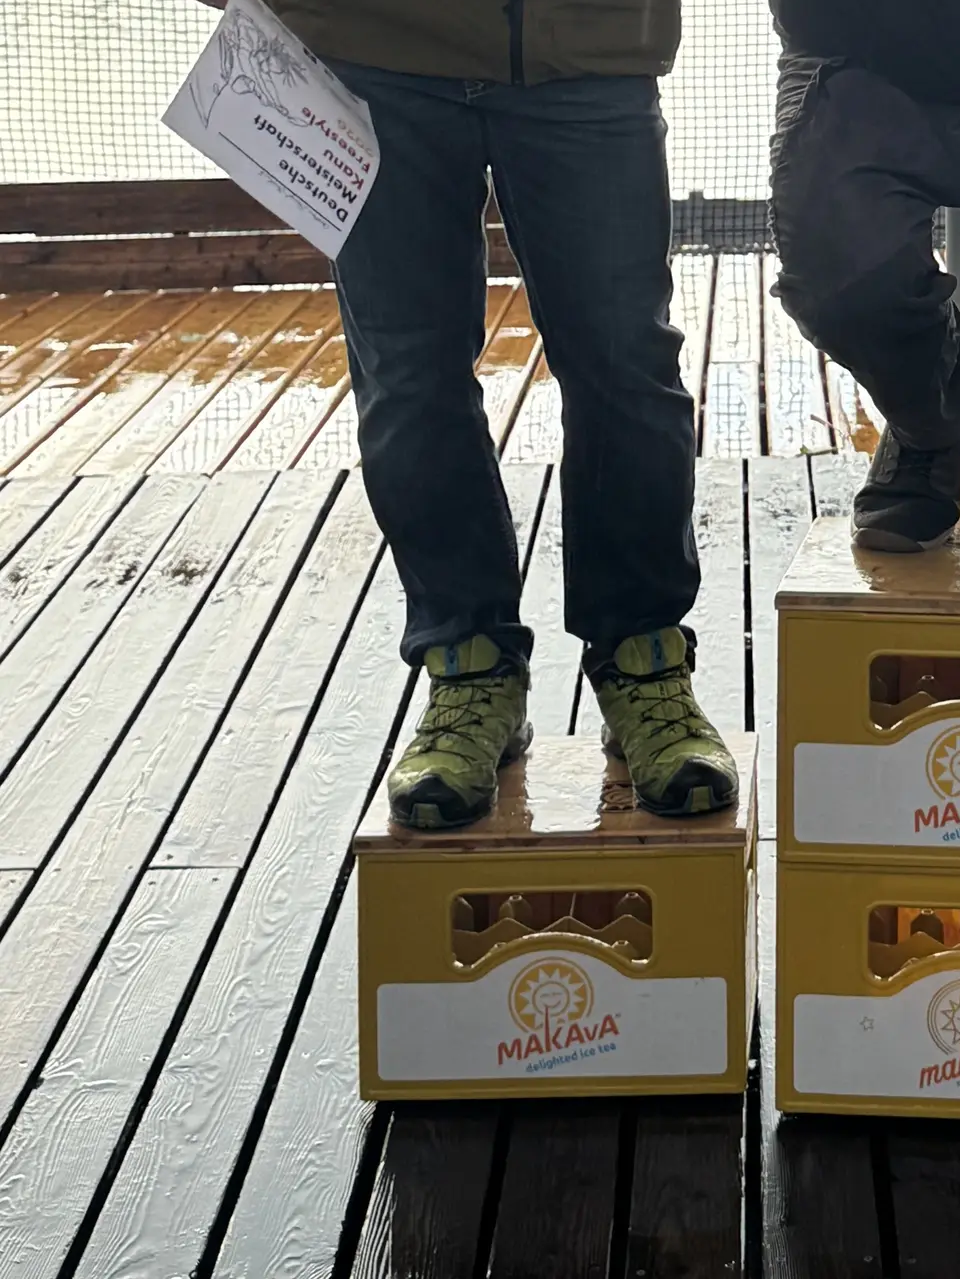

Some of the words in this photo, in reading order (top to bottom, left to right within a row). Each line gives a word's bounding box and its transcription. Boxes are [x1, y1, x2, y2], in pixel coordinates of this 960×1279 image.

[253, 114, 357, 205] Meisterschaft
[302, 106, 370, 174] Freestyle
[323, 149, 364, 191] Kanu
[278, 159, 349, 223] Deutsche
[525, 1050, 578, 1073] delighted
[580, 1045, 597, 1058] ice
[598, 1042, 617, 1054] tea
